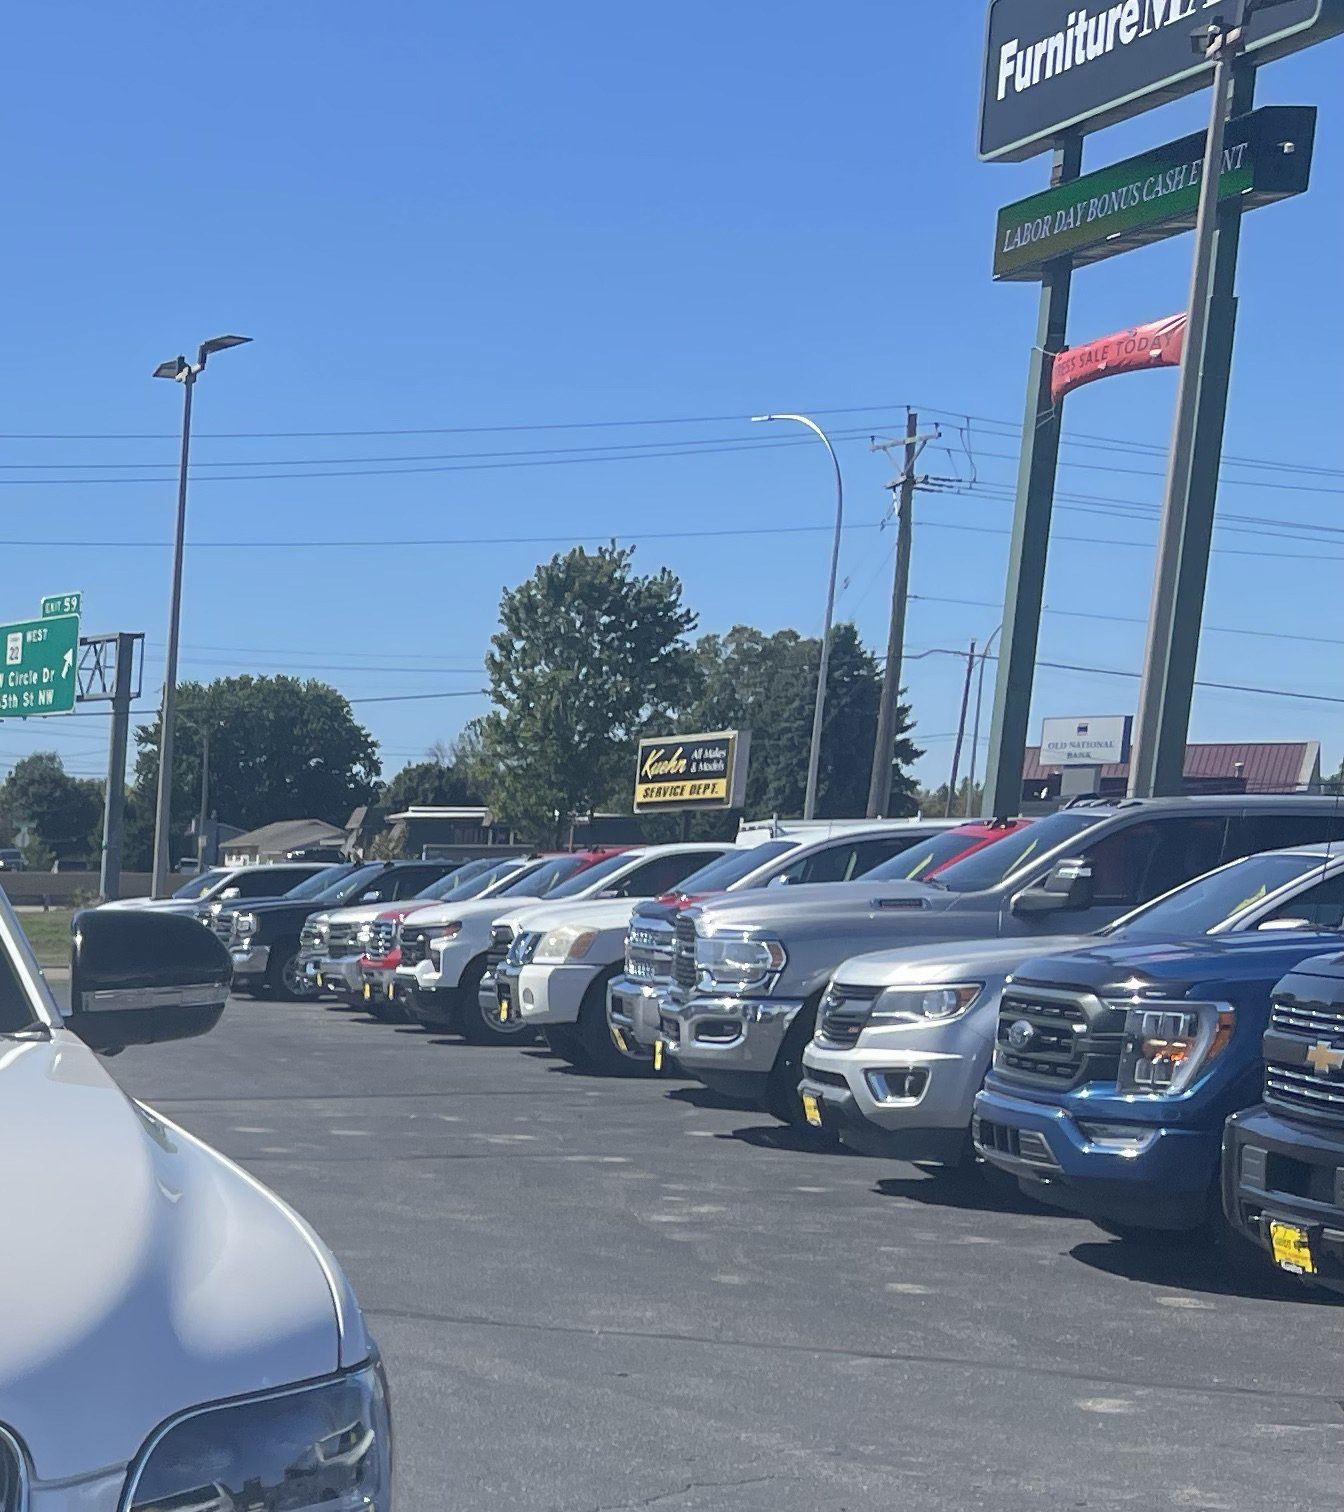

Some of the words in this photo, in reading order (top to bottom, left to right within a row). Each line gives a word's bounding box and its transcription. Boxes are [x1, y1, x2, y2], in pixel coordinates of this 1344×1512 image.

[1002, 214, 1052, 253] LABOR
[1053, 201, 1088, 234] DAY
[1086, 182, 1141, 222] BONUS
[1143, 168, 1184, 202] CASH
[1188, 143, 1248, 186] ENT
[1080, 345, 1110, 368] SALE
[1116, 333, 1172, 357] TODAY
[44, 601, 61, 613] EXIT
[63, 597, 78, 612] 59
[25, 628, 48, 642] WEST
[8, 646, 20, 661] 22
[8, 668, 38, 687] Circle
[42, 667, 55, 683] Dr
[23, 692, 34, 707] St
[38, 689, 55, 706] NW
[1048, 741, 1067, 749] OLD
[1069, 740, 1114, 748] NATIONAL
[691, 748, 703, 760] All
[703, 747, 726, 759] Makes
[1066, 751, 1092, 759] BANK
[641, 746, 687, 780] Kuehn
[690, 762, 696, 773] &
[698, 760, 724, 772] Models
[642, 784, 687, 799] SERVICE
[689, 782, 719, 796] DEPT.
